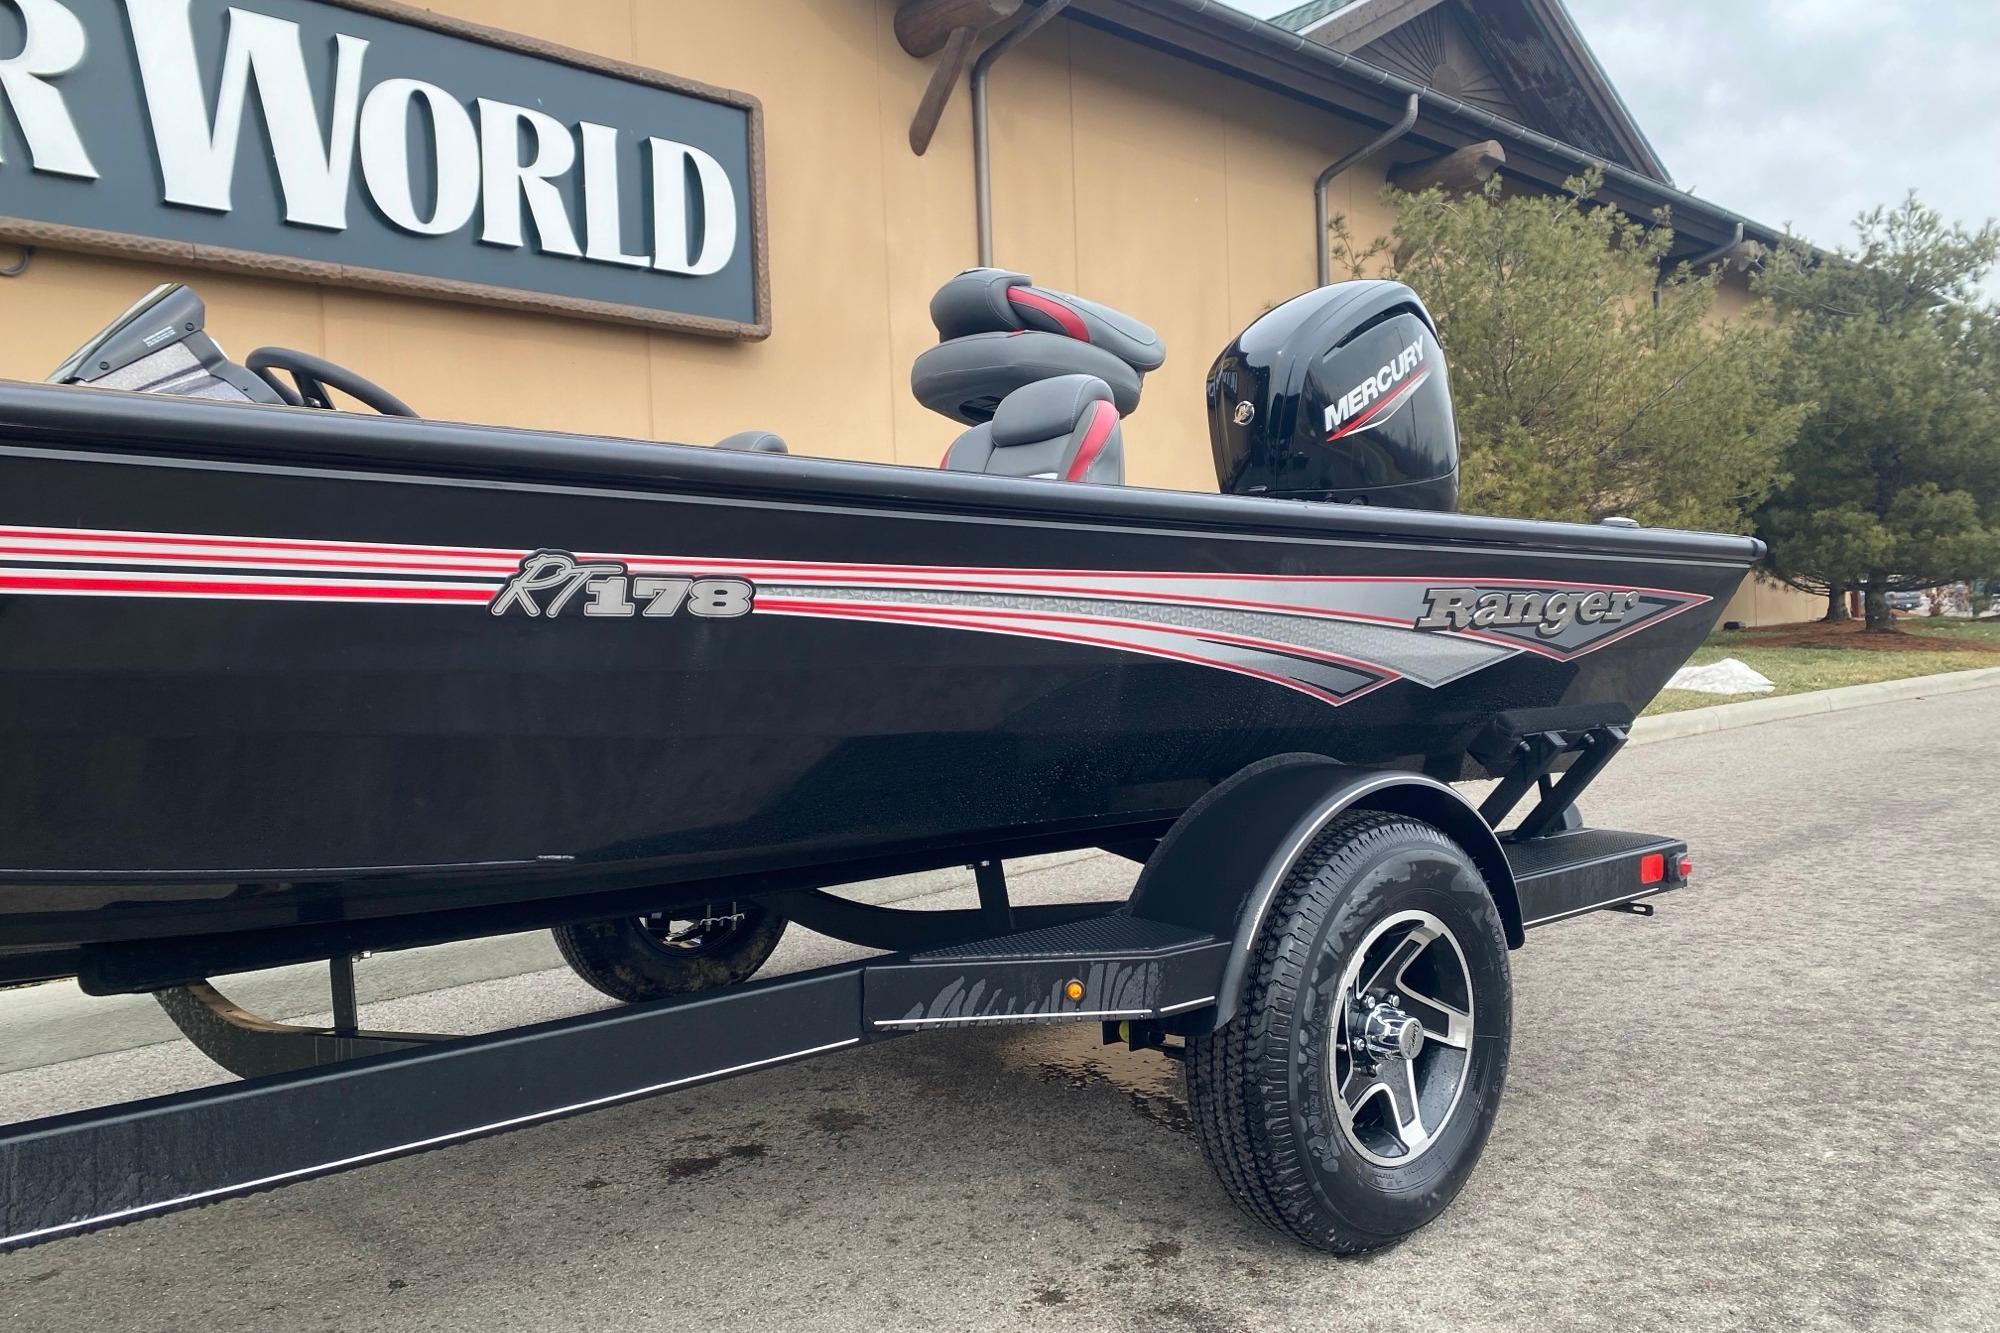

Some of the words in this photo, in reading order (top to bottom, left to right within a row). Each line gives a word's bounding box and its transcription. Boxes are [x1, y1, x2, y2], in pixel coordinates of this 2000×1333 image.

[123, 0, 737, 276] WORLD
[1324, 335, 1425, 432] MERCURY
[1413, 586, 1641, 638] Ranger
